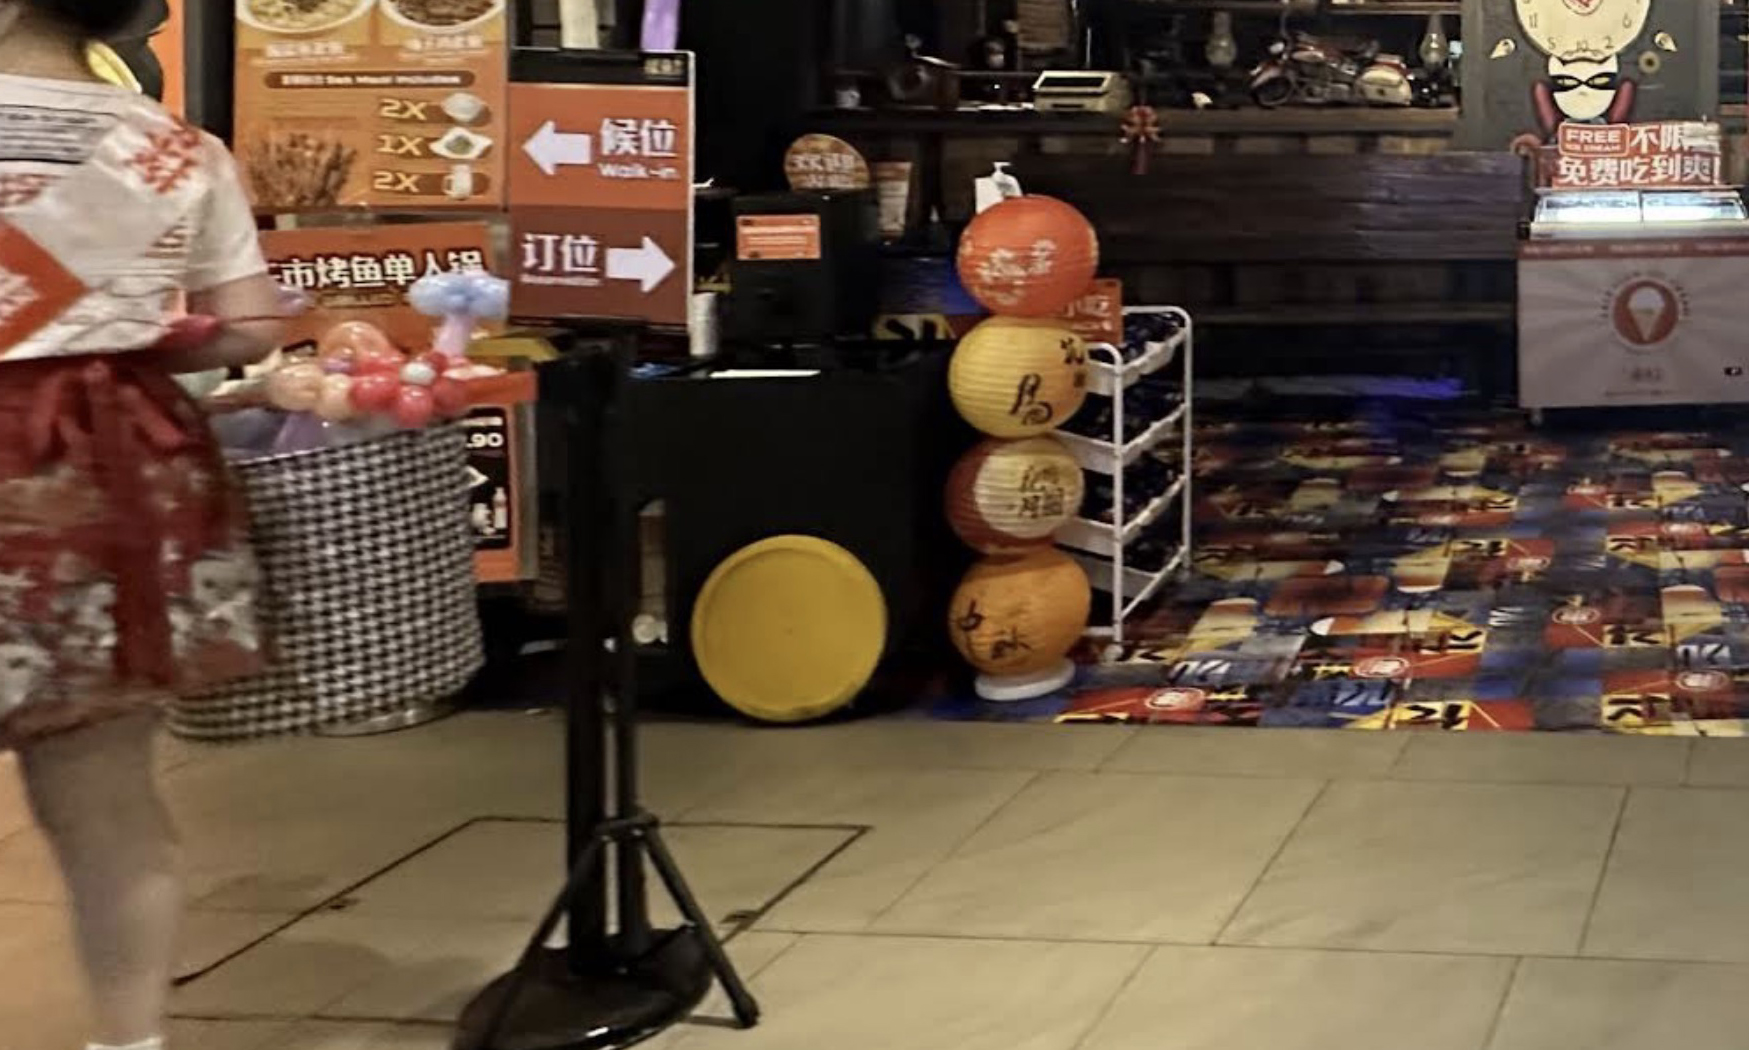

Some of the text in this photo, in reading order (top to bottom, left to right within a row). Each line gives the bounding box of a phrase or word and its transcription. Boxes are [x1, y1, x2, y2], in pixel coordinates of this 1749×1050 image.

[380, 98, 428, 120] 2X
[377, 134, 423, 157] 1X
[600, 118, 678, 158] 候位
[1565, 128, 1621, 144] FREE
[373, 170, 420, 193] 2X
[521, 232, 600, 273] 订位
[268, 250, 483, 288] 市烤鱼单人锅
